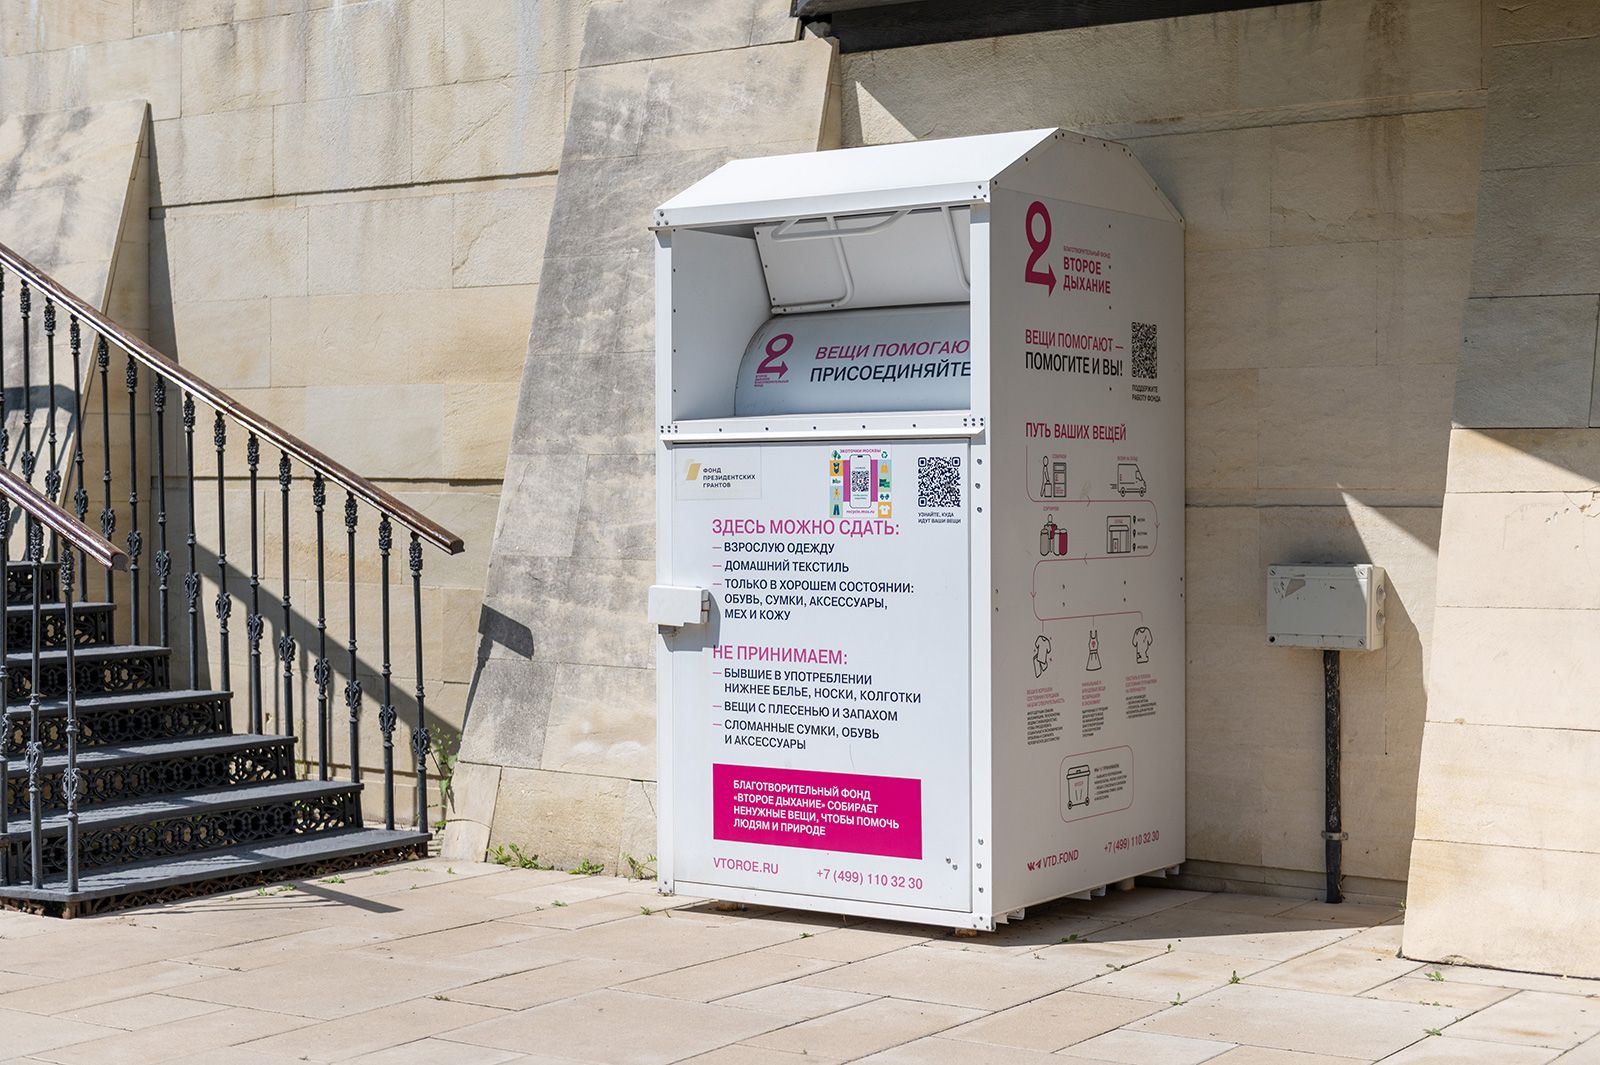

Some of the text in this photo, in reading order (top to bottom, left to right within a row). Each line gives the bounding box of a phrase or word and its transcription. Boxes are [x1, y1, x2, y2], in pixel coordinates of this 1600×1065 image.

[1064, 256, 1101, 275] ВТОРОЕ
[1063, 275, 1111, 294] ДЫХАНИЕ
[1026, 329, 1056, 348] ВЕЩИ
[1058, 333, 1113, 352] ПОМОГАЮТ
[815, 345, 870, 360] ВЕЩИ
[1026, 352, 1123, 376] ПОМОГИТЕ И ВЫ!
[1026, 423, 1126, 442] ПУТЬ ВАШИХ ВЕЩЕЙ
[712, 519, 900, 538] ЗДЕСЬ МОЖНО СДАТЬ:
[724, 542, 834, 556] ВЗРОСЛУЮ ОДЕЖДУ
[724, 559, 849, 573] ДОМАШНИЙ ТЕКСТИЛЬ
[724, 579, 914, 594] ТОЛЬКО В ХОРОШЕМ СОСТОЯНИИ:
[724, 594, 887, 610] ОБУВЬ, СУМКИ, АКСЕССУАРЫ,
[724, 609, 790, 621] МЕХ И КОЖУ
[713, 644, 847, 664] НЕ ПРИНИМАЕМ:
[724, 668, 872, 685] БЫВШИЕ В УПОТРЕБЛЕНИИ
[724, 683, 921, 703] НИЖНЕЕ БЕЛЬЕ, НОСКИ, КОЛГОТКИ
[724, 701, 898, 721] ВЕЩИ С ПЛЕСЕНЬЮ И ЗАПАХОМ
[724, 719, 880, 740] СЛОМАННЫЕ СУМКИ, ОБУВЬ
[724, 734, 806, 750] И АКСЕССУАРЫ
[733, 779, 871, 802] БЛАГОТВОРИТЕЛЬНЫЙ ФОНД
[733, 794, 878, 814] «ВТОРОЕ ДЫХАНИЕ» СОБИРАЕТ
[733, 805, 899, 830] НЕНУЖНЫЕ ВЕЩИ, ЧТОБЫ ПОМОЧЬ
[733, 818, 826, 836] ЛЮДЯМ И ПРИРОДЕ
[1104, 830, 1160, 853] +7 (499) 110 32 30
[713, 857, 779, 875] VTOROE.RU
[1043, 849, 1079, 868] VTD.FOND
[816, 867, 923, 890] +7 (499) 110 32 30
